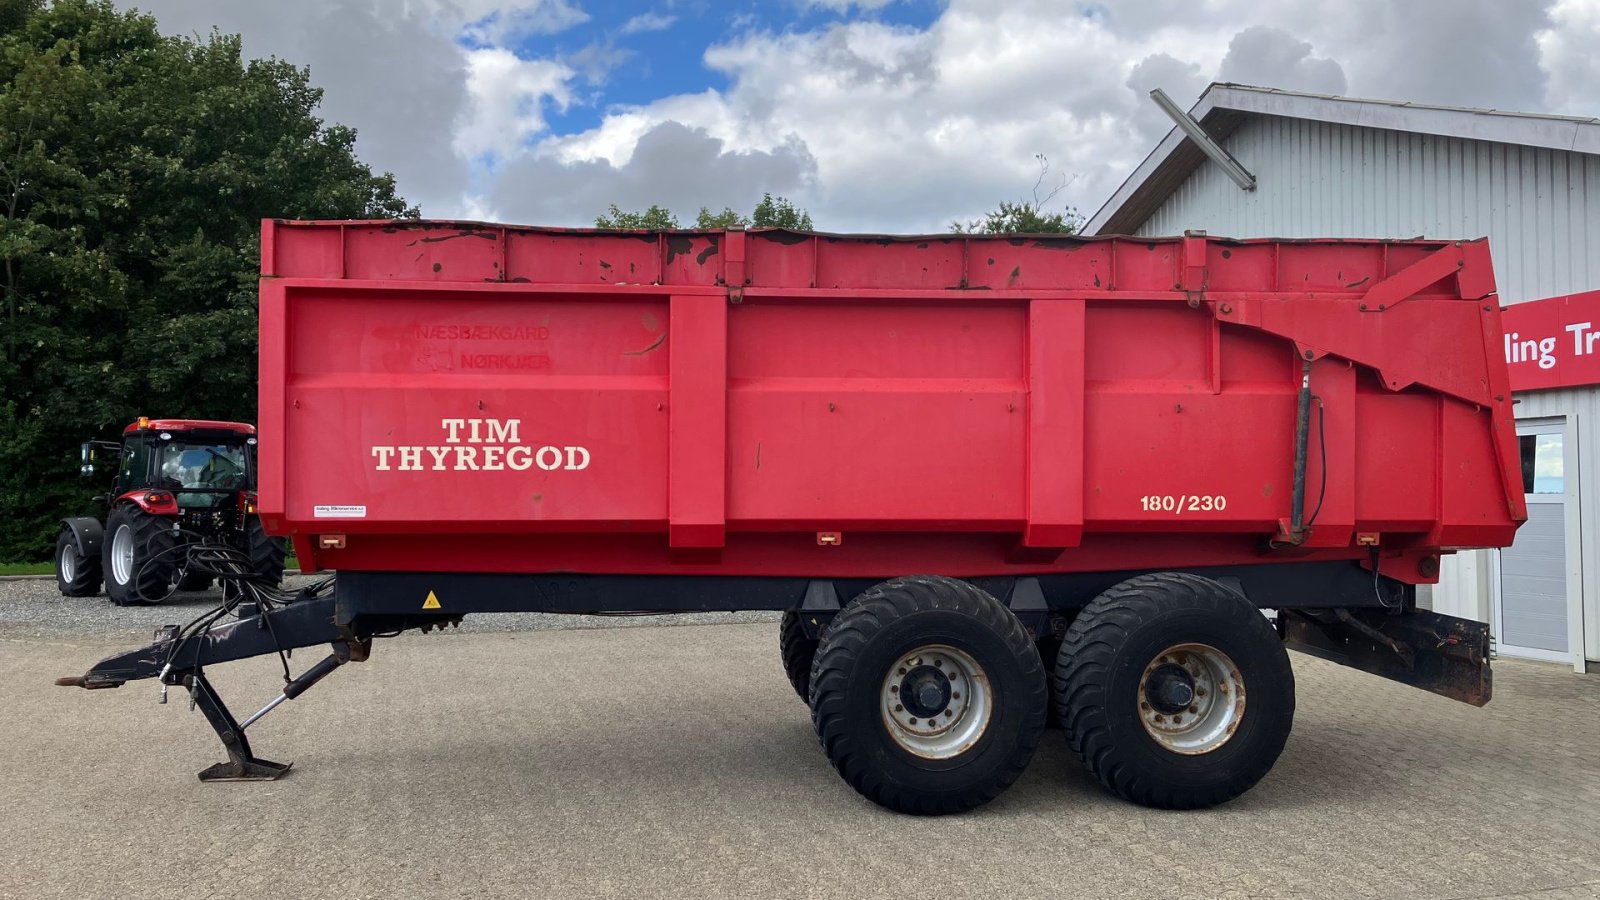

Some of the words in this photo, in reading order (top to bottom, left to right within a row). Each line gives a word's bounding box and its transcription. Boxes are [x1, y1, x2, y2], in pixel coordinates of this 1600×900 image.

[442, 419, 521, 443] TIM
[372, 446, 590, 471] THYREGOD
[1140, 495, 1227, 514] 180/230
